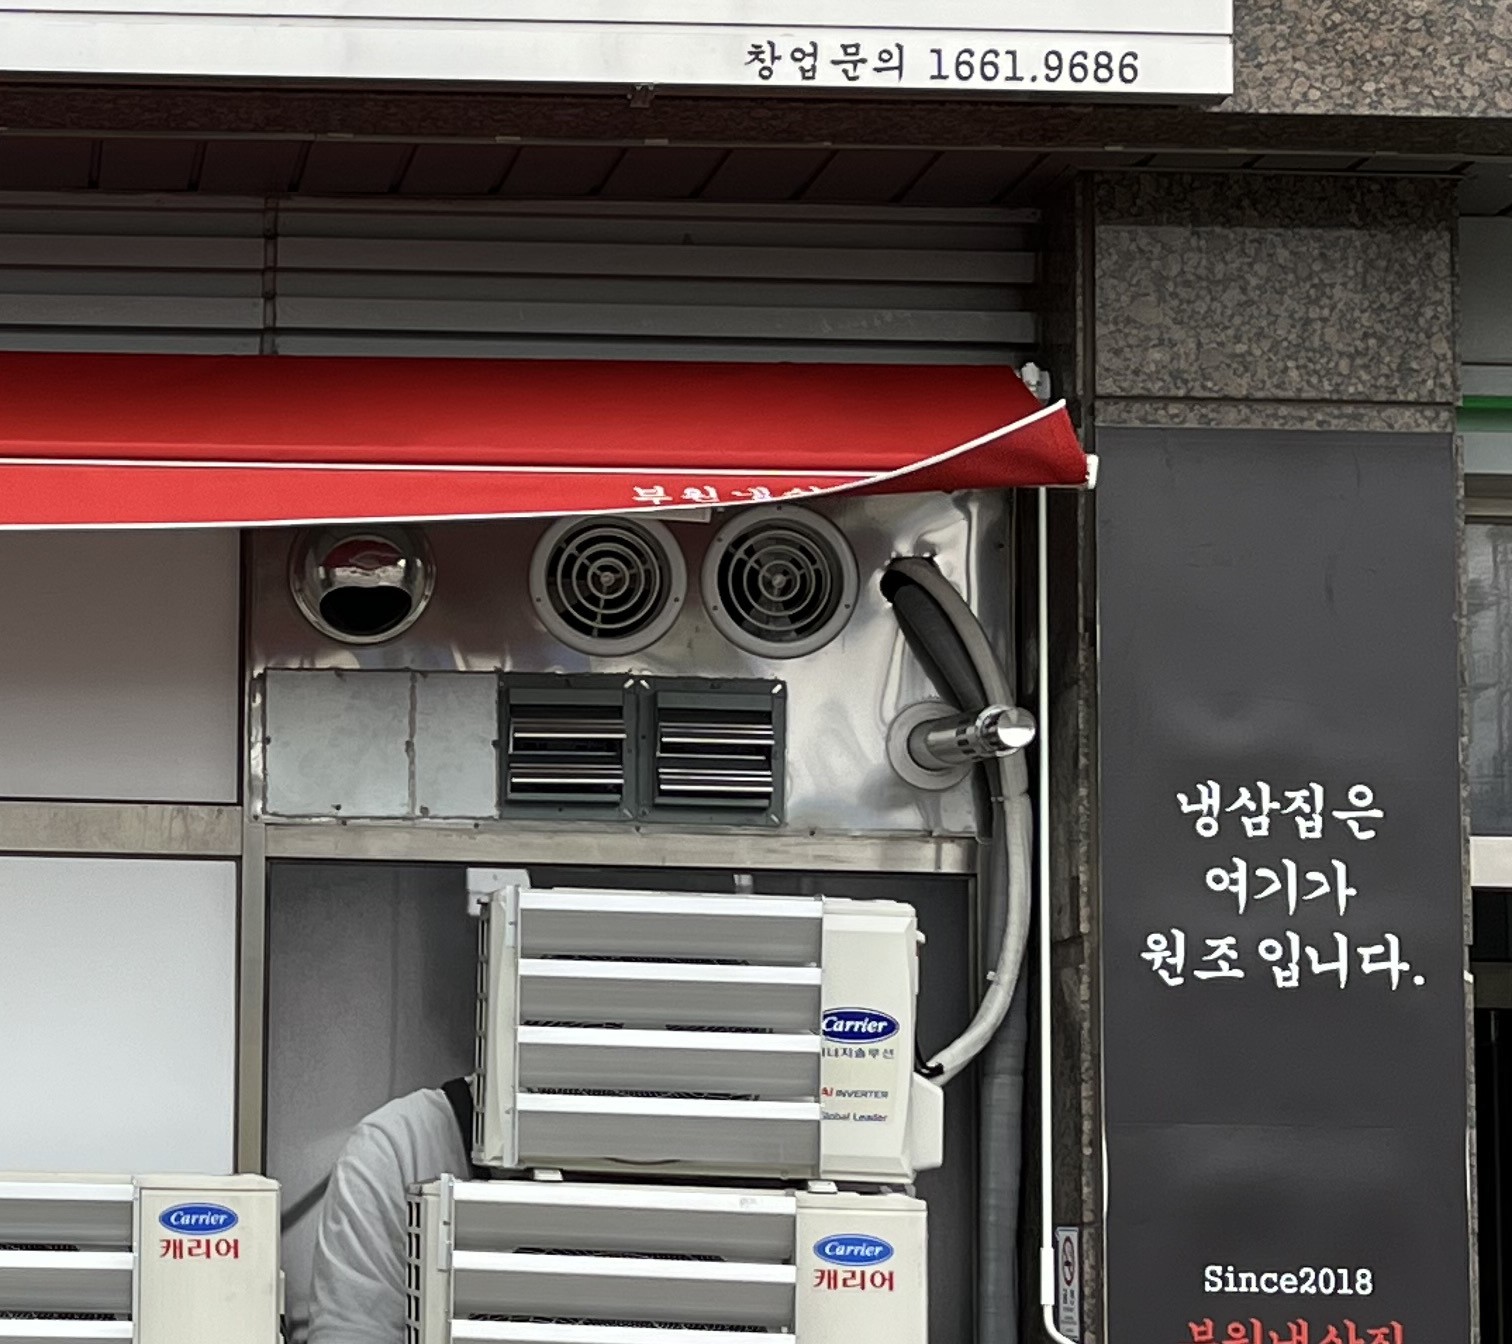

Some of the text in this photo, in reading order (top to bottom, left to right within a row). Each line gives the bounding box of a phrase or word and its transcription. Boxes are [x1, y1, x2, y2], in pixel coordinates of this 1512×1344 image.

[744, 40, 1141, 86] 창업문의 1661.9686
[1176, 779, 1384, 841] 냉삼집은
[1205, 856, 1358, 917] 여기가
[822, 1016, 888, 1033] Carrier
[822, 1047, 895, 1059] 너지솔루션
[835, 1089, 889, 1099] INVERTER
[169, 1210, 228, 1225] Carrier
[159, 1238, 239, 1259] 캐리어
[824, 1241, 883, 1256] Carrier
[813, 1269, 894, 1291] 캐리어
[1204, 1265, 1374, 1295] Since2018
